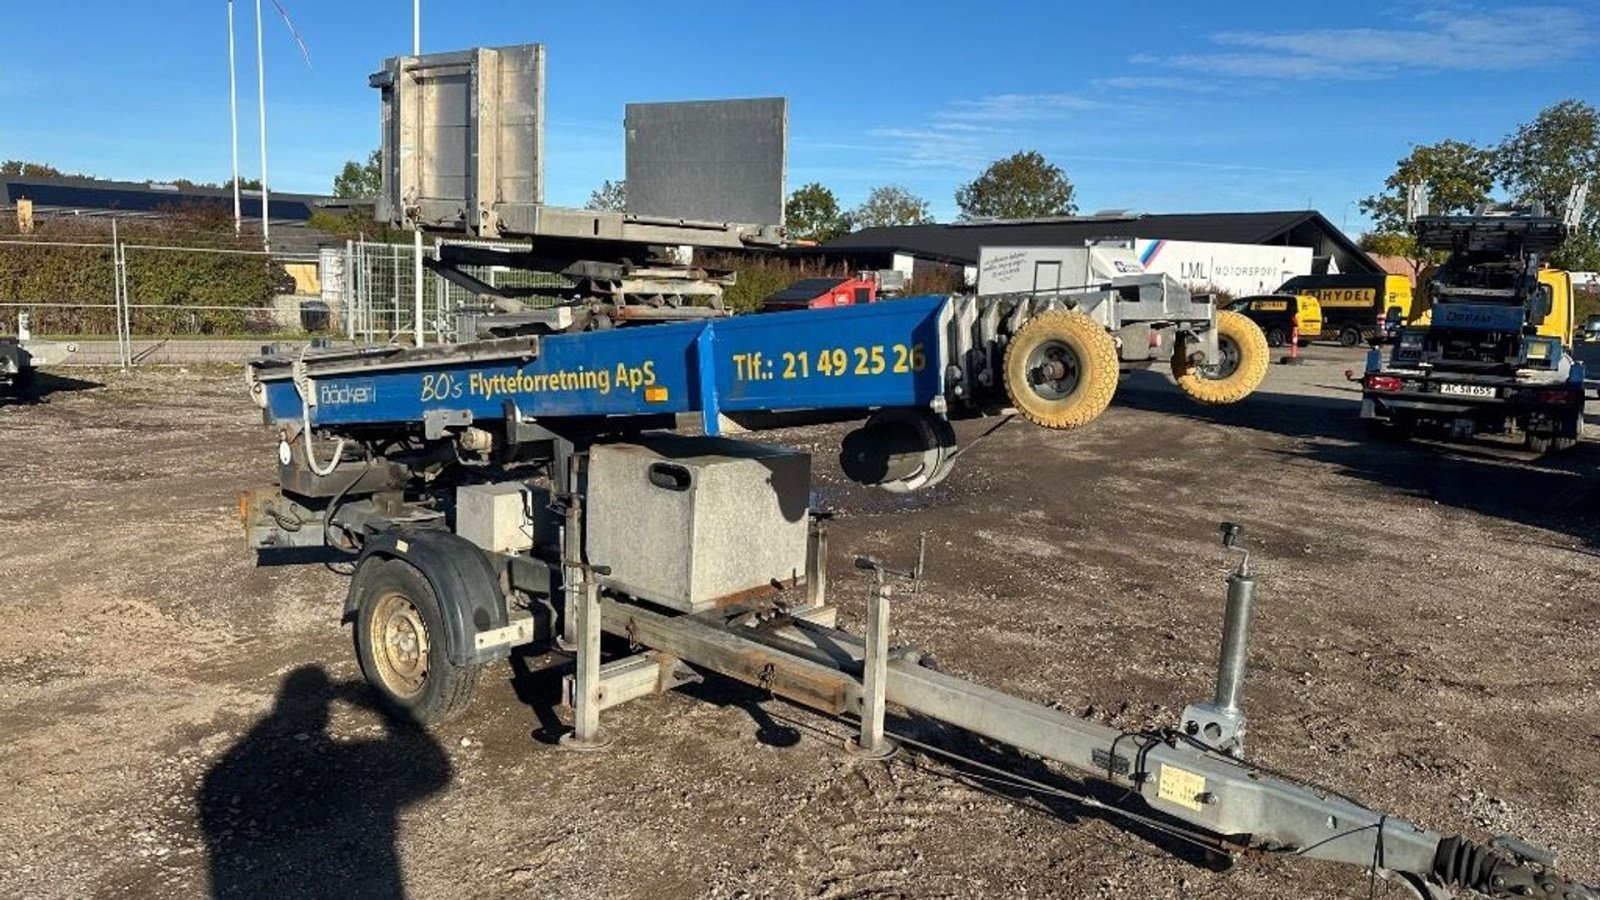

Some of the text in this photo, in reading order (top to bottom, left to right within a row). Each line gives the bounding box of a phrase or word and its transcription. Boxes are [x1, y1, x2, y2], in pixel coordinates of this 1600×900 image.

[1180, 261, 1278, 280] LML MOTORSPORT
[469, 365, 611, 401] Flytteforretning
[615, 360, 656, 393] ApS
[732, 343, 926, 381] Tlf.: 21 49 25 26
